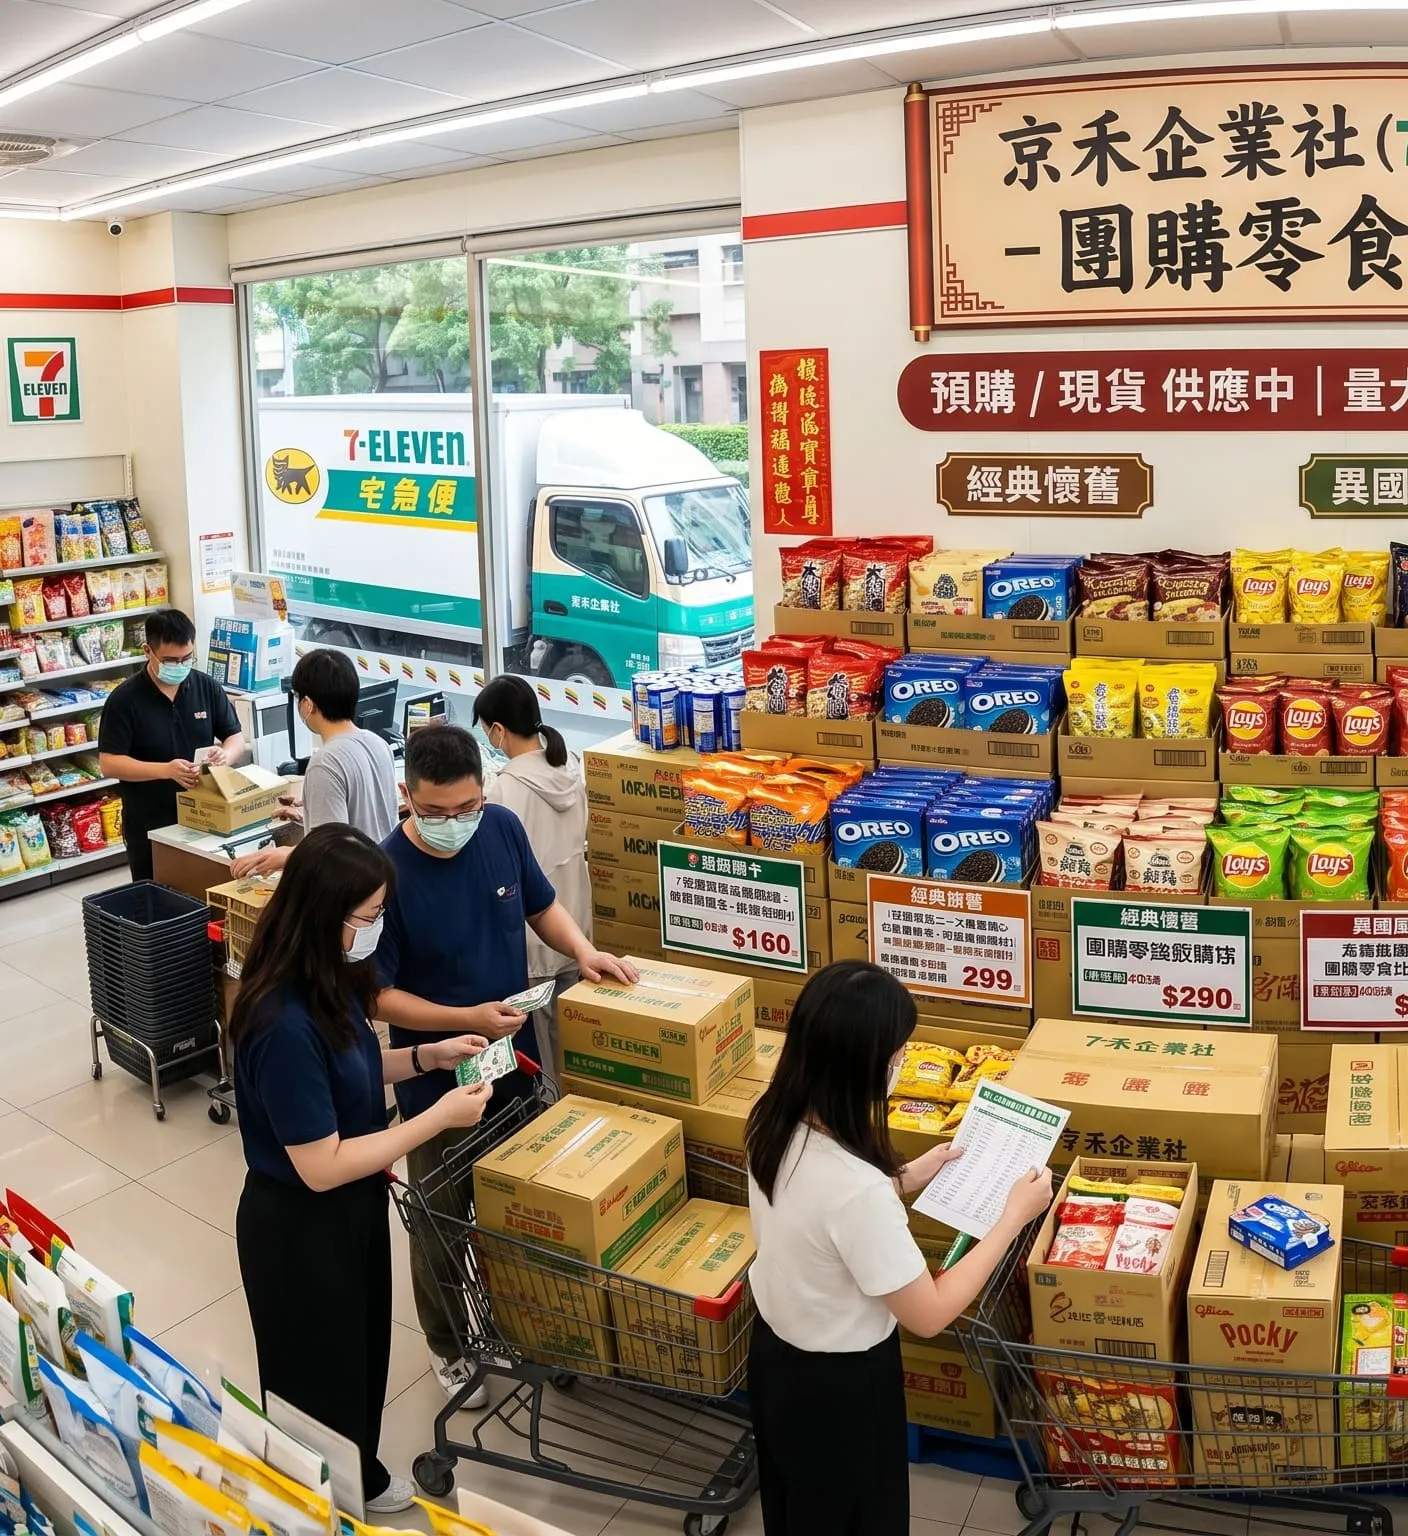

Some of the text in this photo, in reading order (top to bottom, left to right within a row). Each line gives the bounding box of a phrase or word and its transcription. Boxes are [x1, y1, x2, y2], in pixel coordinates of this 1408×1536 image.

[930, 369, 1016, 415] 預購
[1058, 369, 1147, 414] 現貨
[1161, 368, 1295, 414] 供應中
[359, 475, 458, 516] 宅急便
[966, 465, 1121, 506] 經典懷舊
[990, 577, 1055, 597] OREO
[892, 679, 958, 701] OREO
[971, 691, 1040, 711] OREO
[838, 821, 911, 842] OREO
[933, 830, 1011, 853] OREO
[732, 926, 791, 955] $160
[962, 965, 1013, 991] 299
[1162, 984, 1233, 1010] $290
